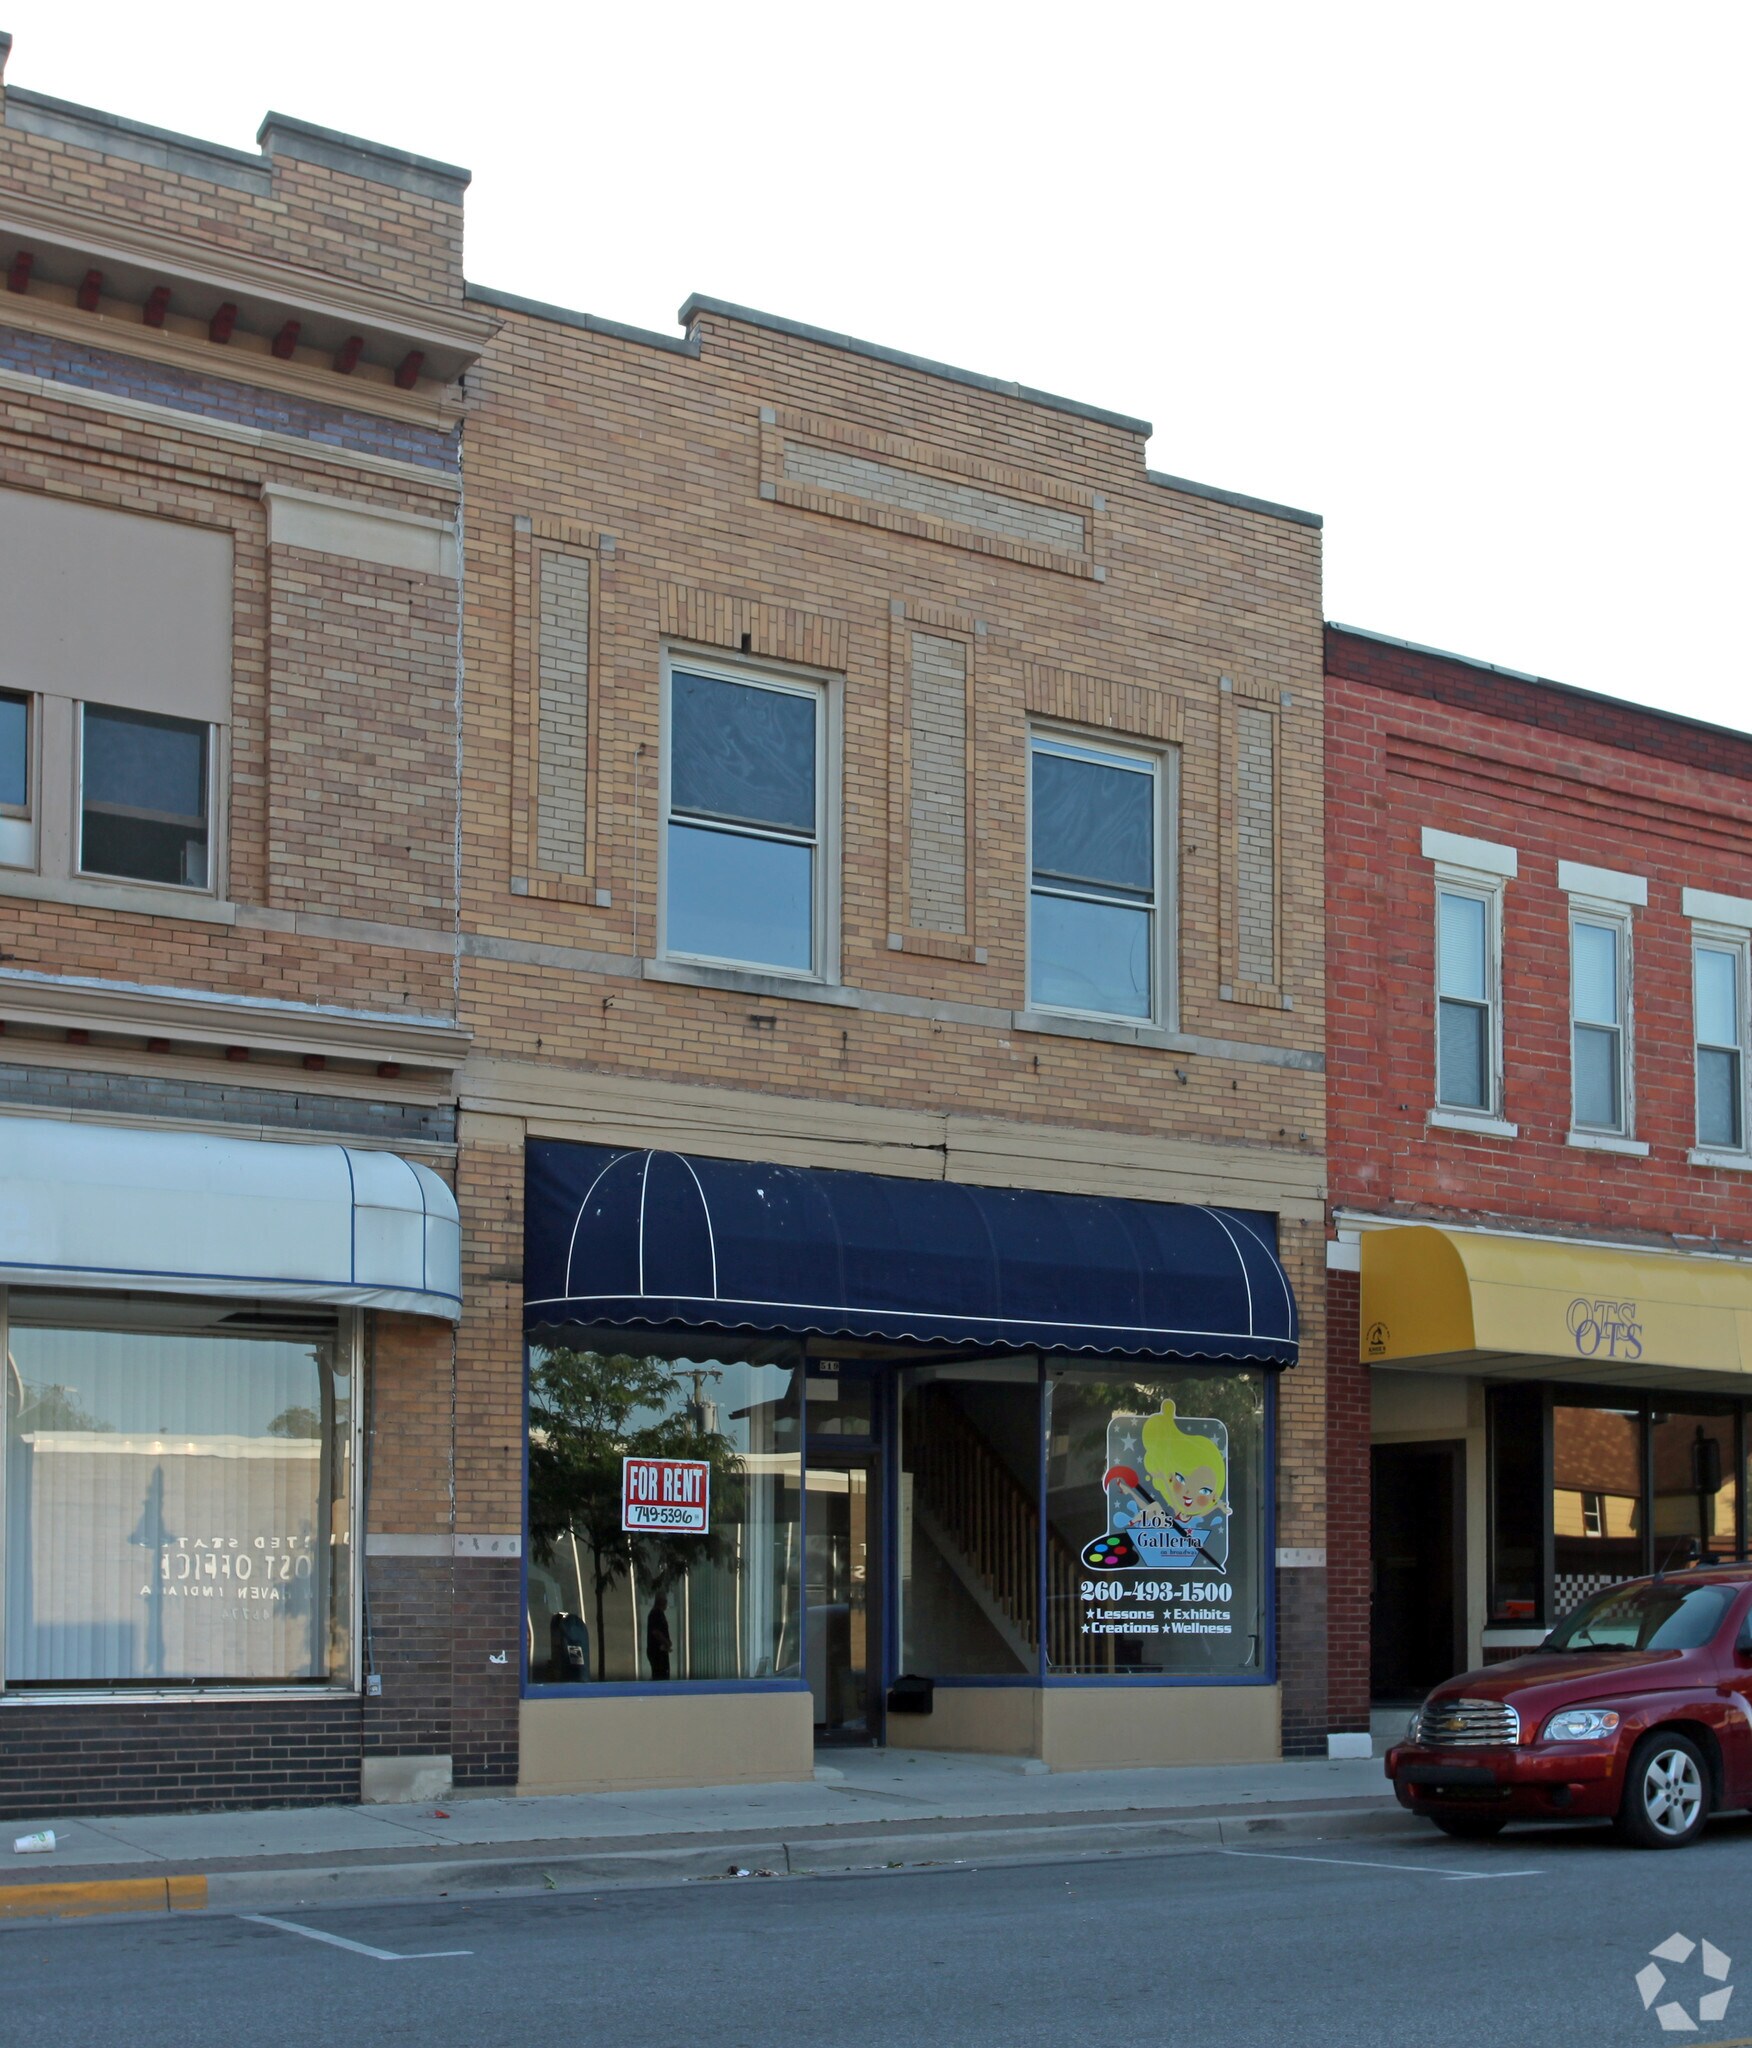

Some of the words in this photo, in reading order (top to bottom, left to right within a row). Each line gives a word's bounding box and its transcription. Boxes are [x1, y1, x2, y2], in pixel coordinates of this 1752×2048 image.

[1566, 1298, 1636, 1341] OTS
[1575, 1319, 1644, 1360] OTS
[630, 1466, 658, 1501] FOR
[663, 1467, 703, 1503] RENT
[635, 1506, 692, 1524] 749-5396
[1141, 1510, 1174, 1528] Lo's
[1137, 1531, 1202, 1548] Galleria
[1080, 1581, 1233, 1602] 260-493-1500
[1096, 1608, 1154, 1620] Lessons
[1173, 1609, 1230, 1620] Exhibits
[1091, 1622, 1159, 1634] Creations
[1171, 1622, 1232, 1634] Wellness
